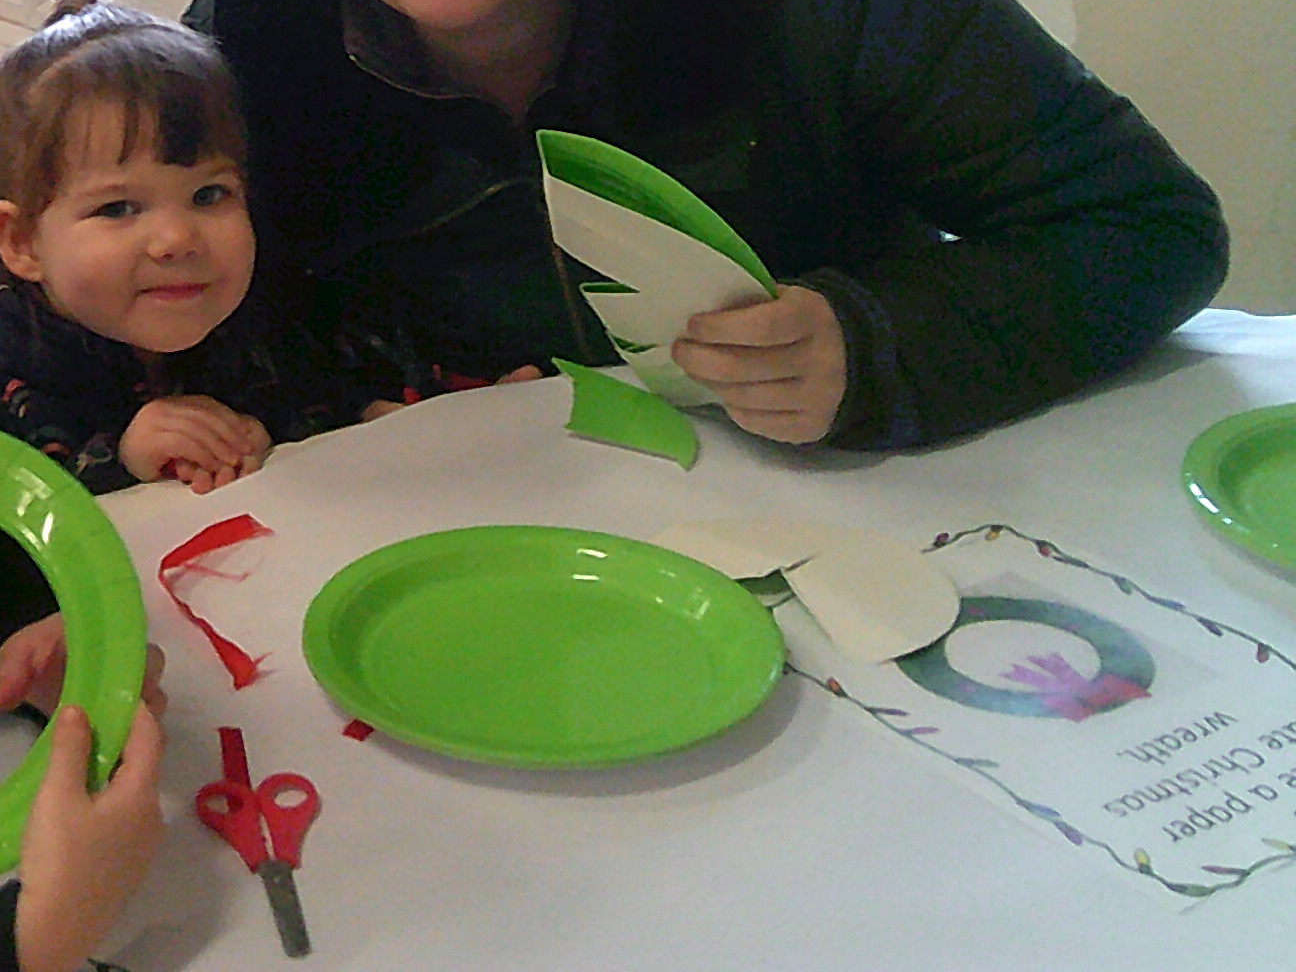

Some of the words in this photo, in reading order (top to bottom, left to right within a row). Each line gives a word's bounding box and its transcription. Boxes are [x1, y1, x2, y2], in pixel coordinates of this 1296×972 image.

[1116, 712, 1240, 766] wreath.
[1103, 747, 1265, 818] Christmas
[1247, 784, 1278, 802] a
[1162, 790, 1255, 843] paper
